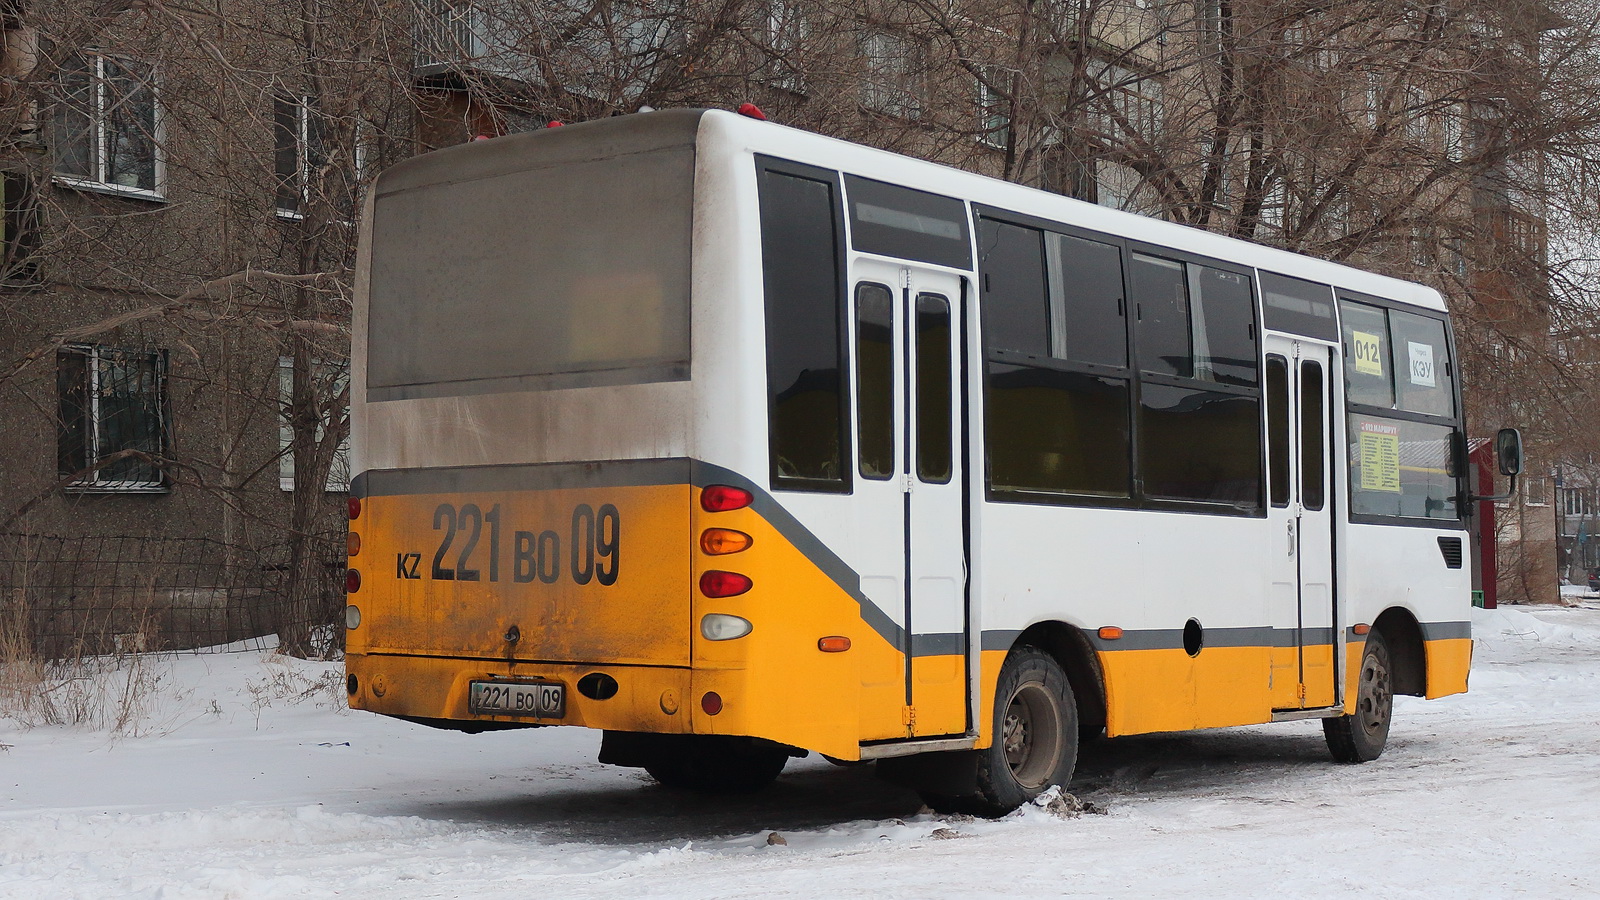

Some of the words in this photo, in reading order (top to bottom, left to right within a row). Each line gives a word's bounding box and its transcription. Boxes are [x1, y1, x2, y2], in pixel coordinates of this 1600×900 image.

[1355, 339, 1379, 363] 012
[1412, 359, 1431, 378] КЭУ
[396, 552, 421, 580] KZ
[432, 503, 501, 583] 221
[571, 503, 621, 587] 09
[482, 686, 510, 710] 221
[541, 688, 561, 711] 09
